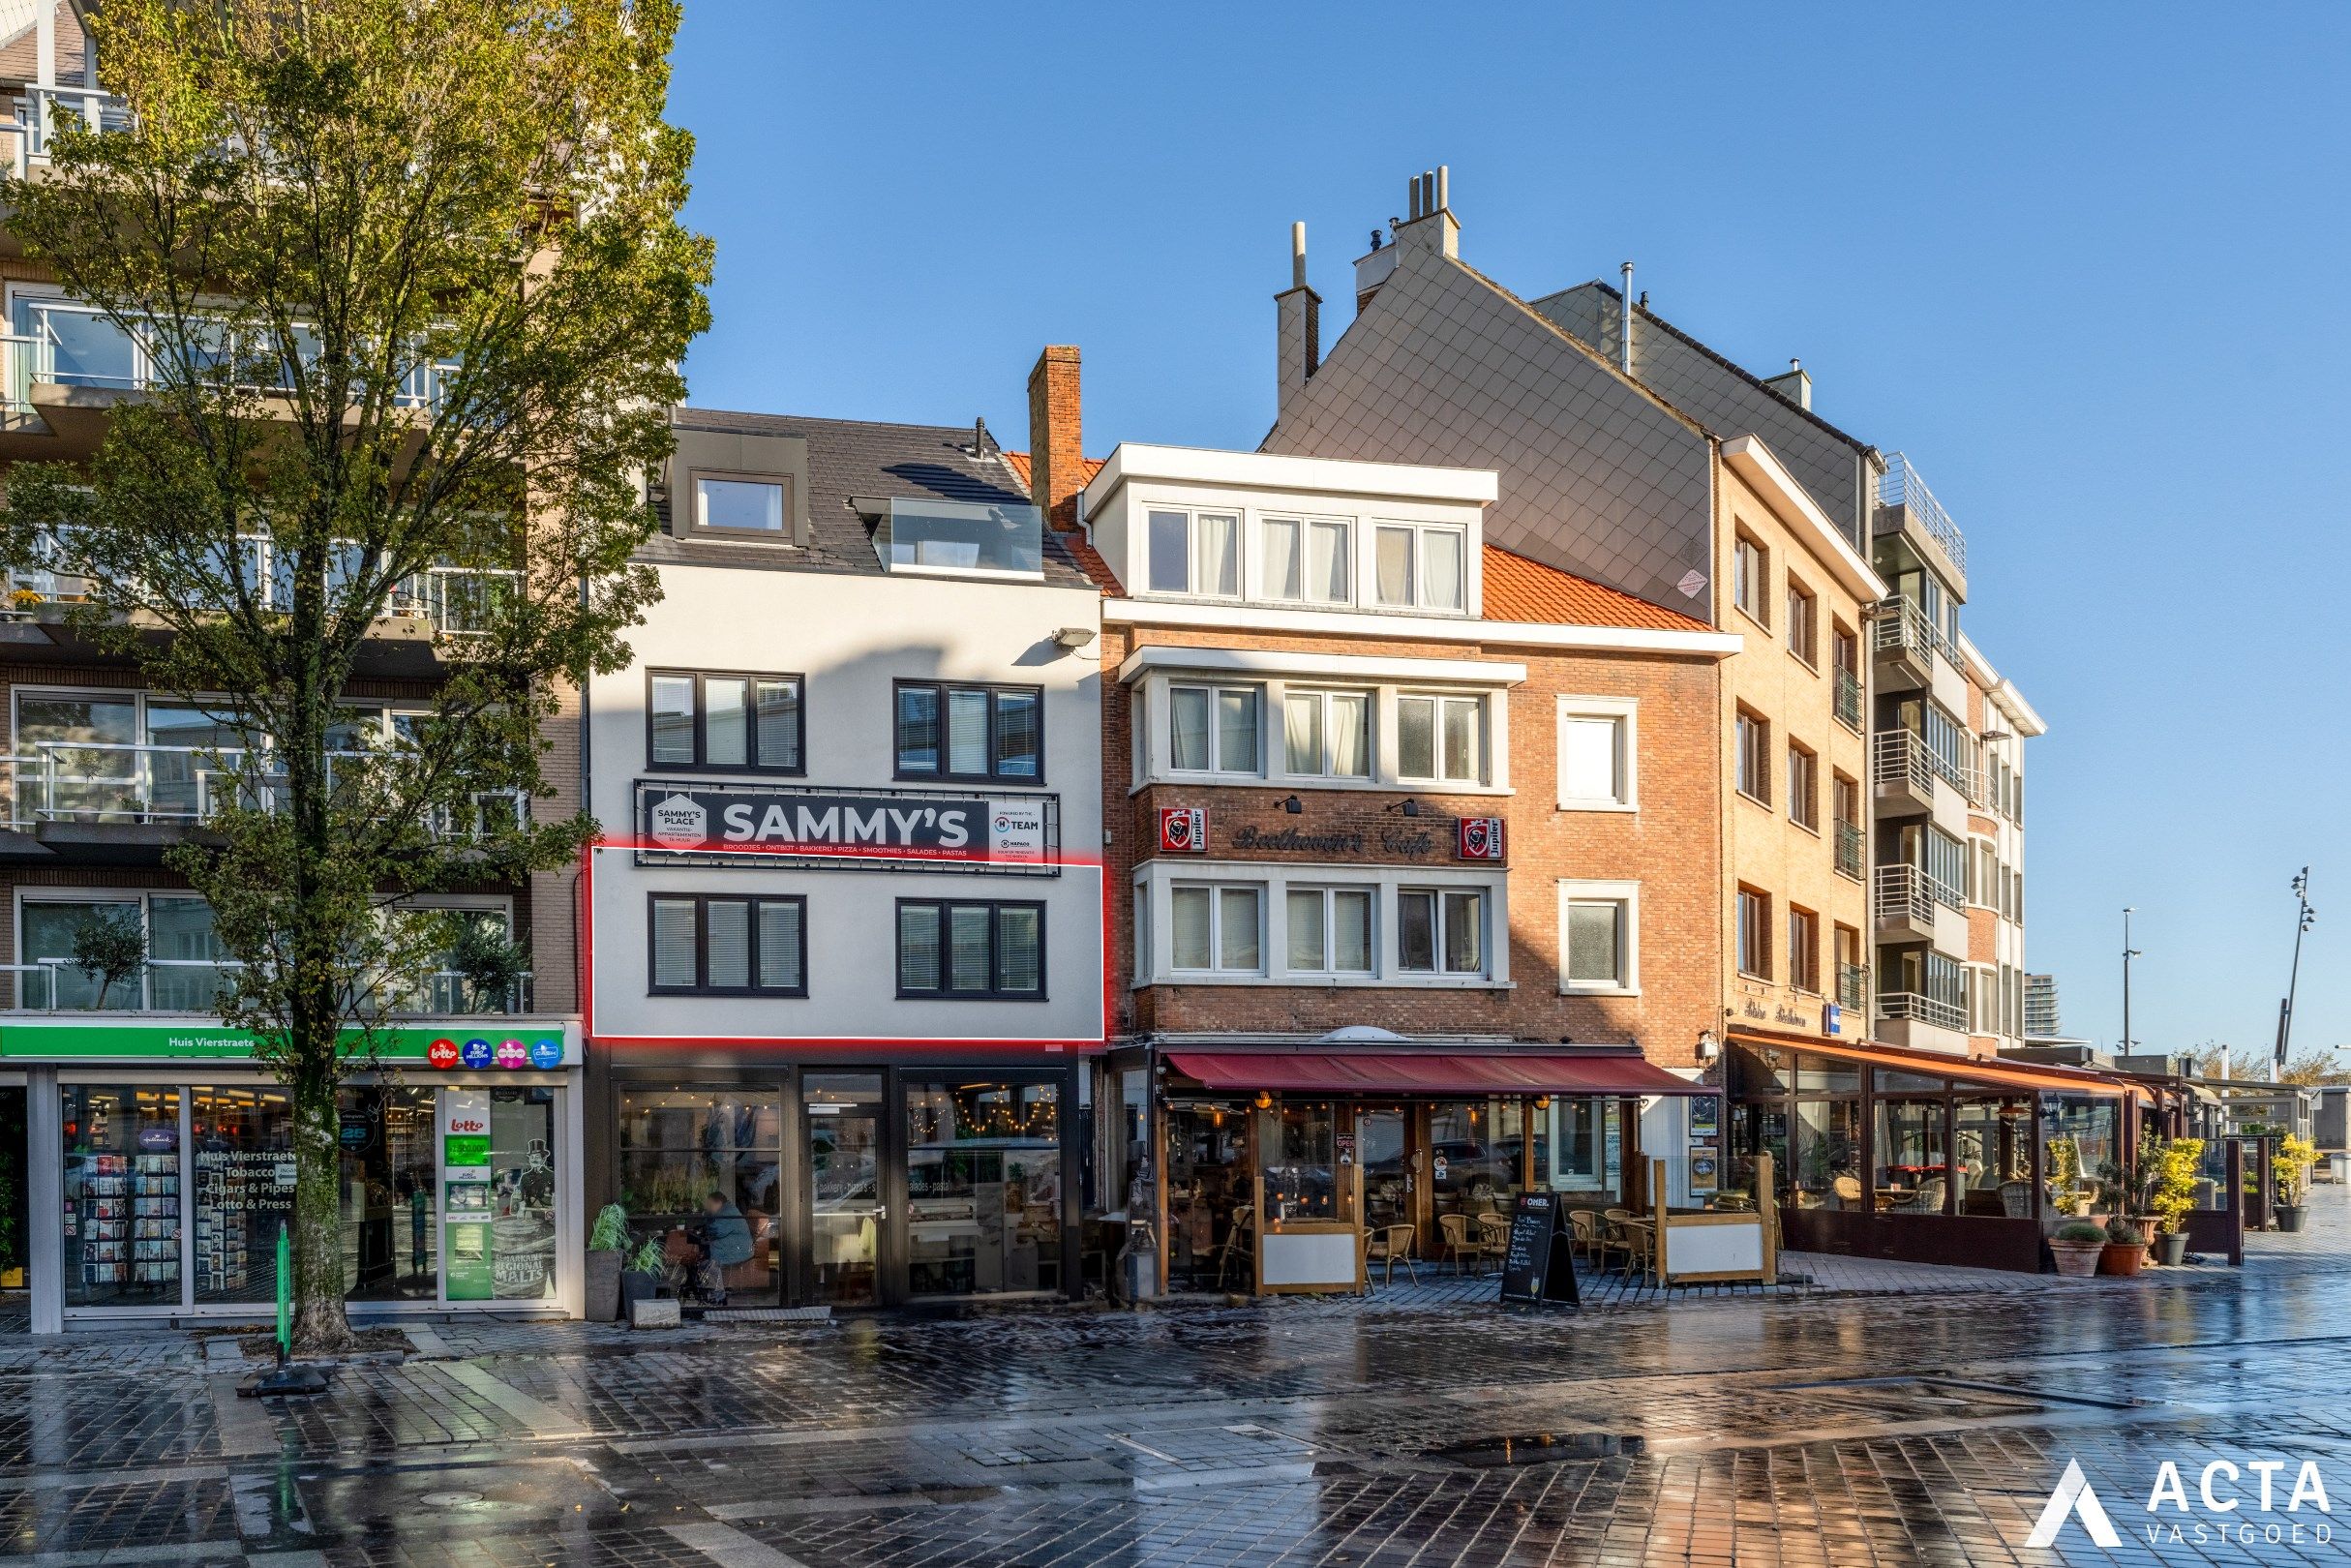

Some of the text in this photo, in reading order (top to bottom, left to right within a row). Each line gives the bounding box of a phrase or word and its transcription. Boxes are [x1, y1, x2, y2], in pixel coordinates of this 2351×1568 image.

[657, 809, 701, 819] SAMMY'S
[723, 804, 969, 848] SAMMY'S
[1010, 821, 1039, 830] TEAM
[1192, 810, 1204, 848] Jupiler
[1490, 820, 1499, 856] Jupiler
[168, 1037, 255, 1047] Huis Vierstraete
[450, 1118, 484, 1132] Lotto
[340, 1128, 367, 1139] 25
[143, 1135, 172, 1145] Hallmark
[1337, 1139, 1354, 1148] OPEN
[200, 1150, 228, 1161] Huis
[225, 1166, 276, 1178] Tobacco
[206, 1183, 295, 1196] Cigars & Pipes
[909, 1180, 929, 1191] alades
[246, 1199, 256, 1210] &
[258, 1199, 292, 1210] Press
[495, 1269, 544, 1283] MALTS
